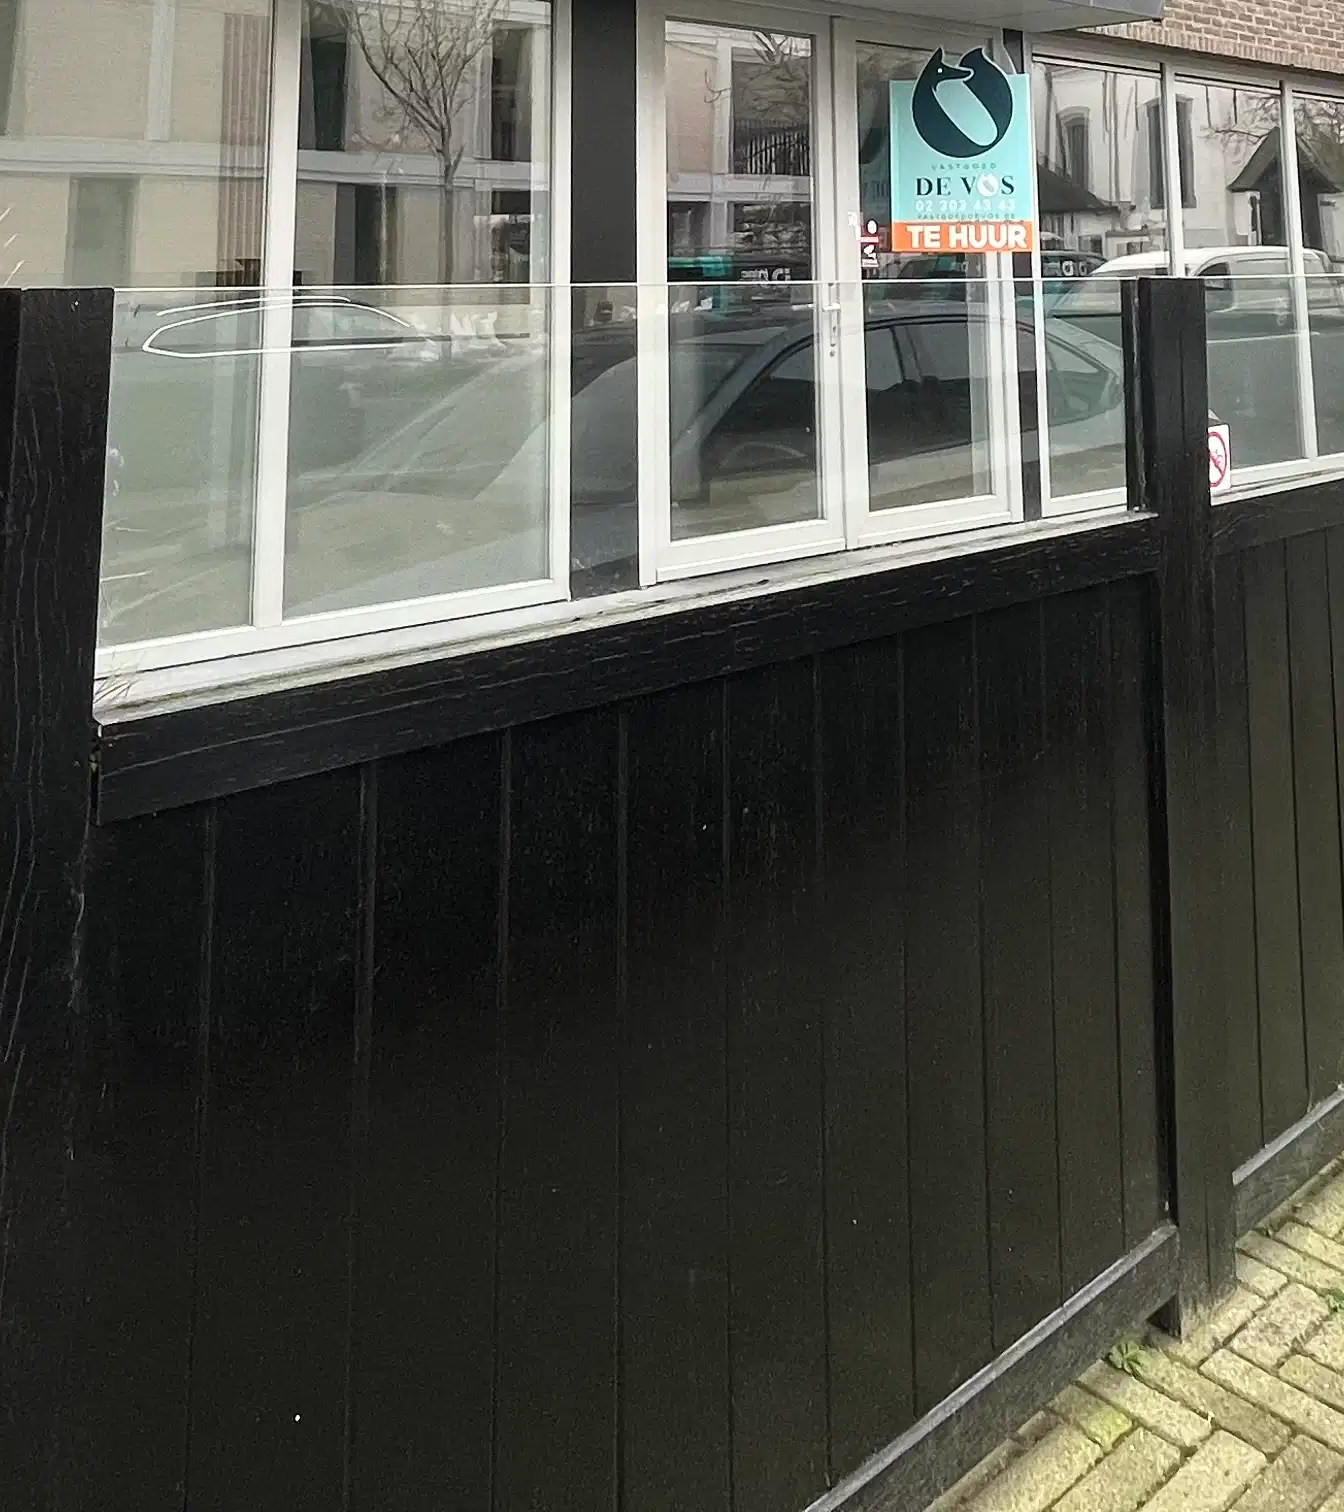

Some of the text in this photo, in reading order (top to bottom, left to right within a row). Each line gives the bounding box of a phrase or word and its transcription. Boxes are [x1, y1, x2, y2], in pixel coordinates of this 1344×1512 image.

[931, 162, 997, 171] VASTGOED
[916, 174, 1015, 197] DE VOS
[915, 200, 934, 212] 02
[939, 199, 967, 212] 303
[906, 224, 1028, 249] TE HUUR
